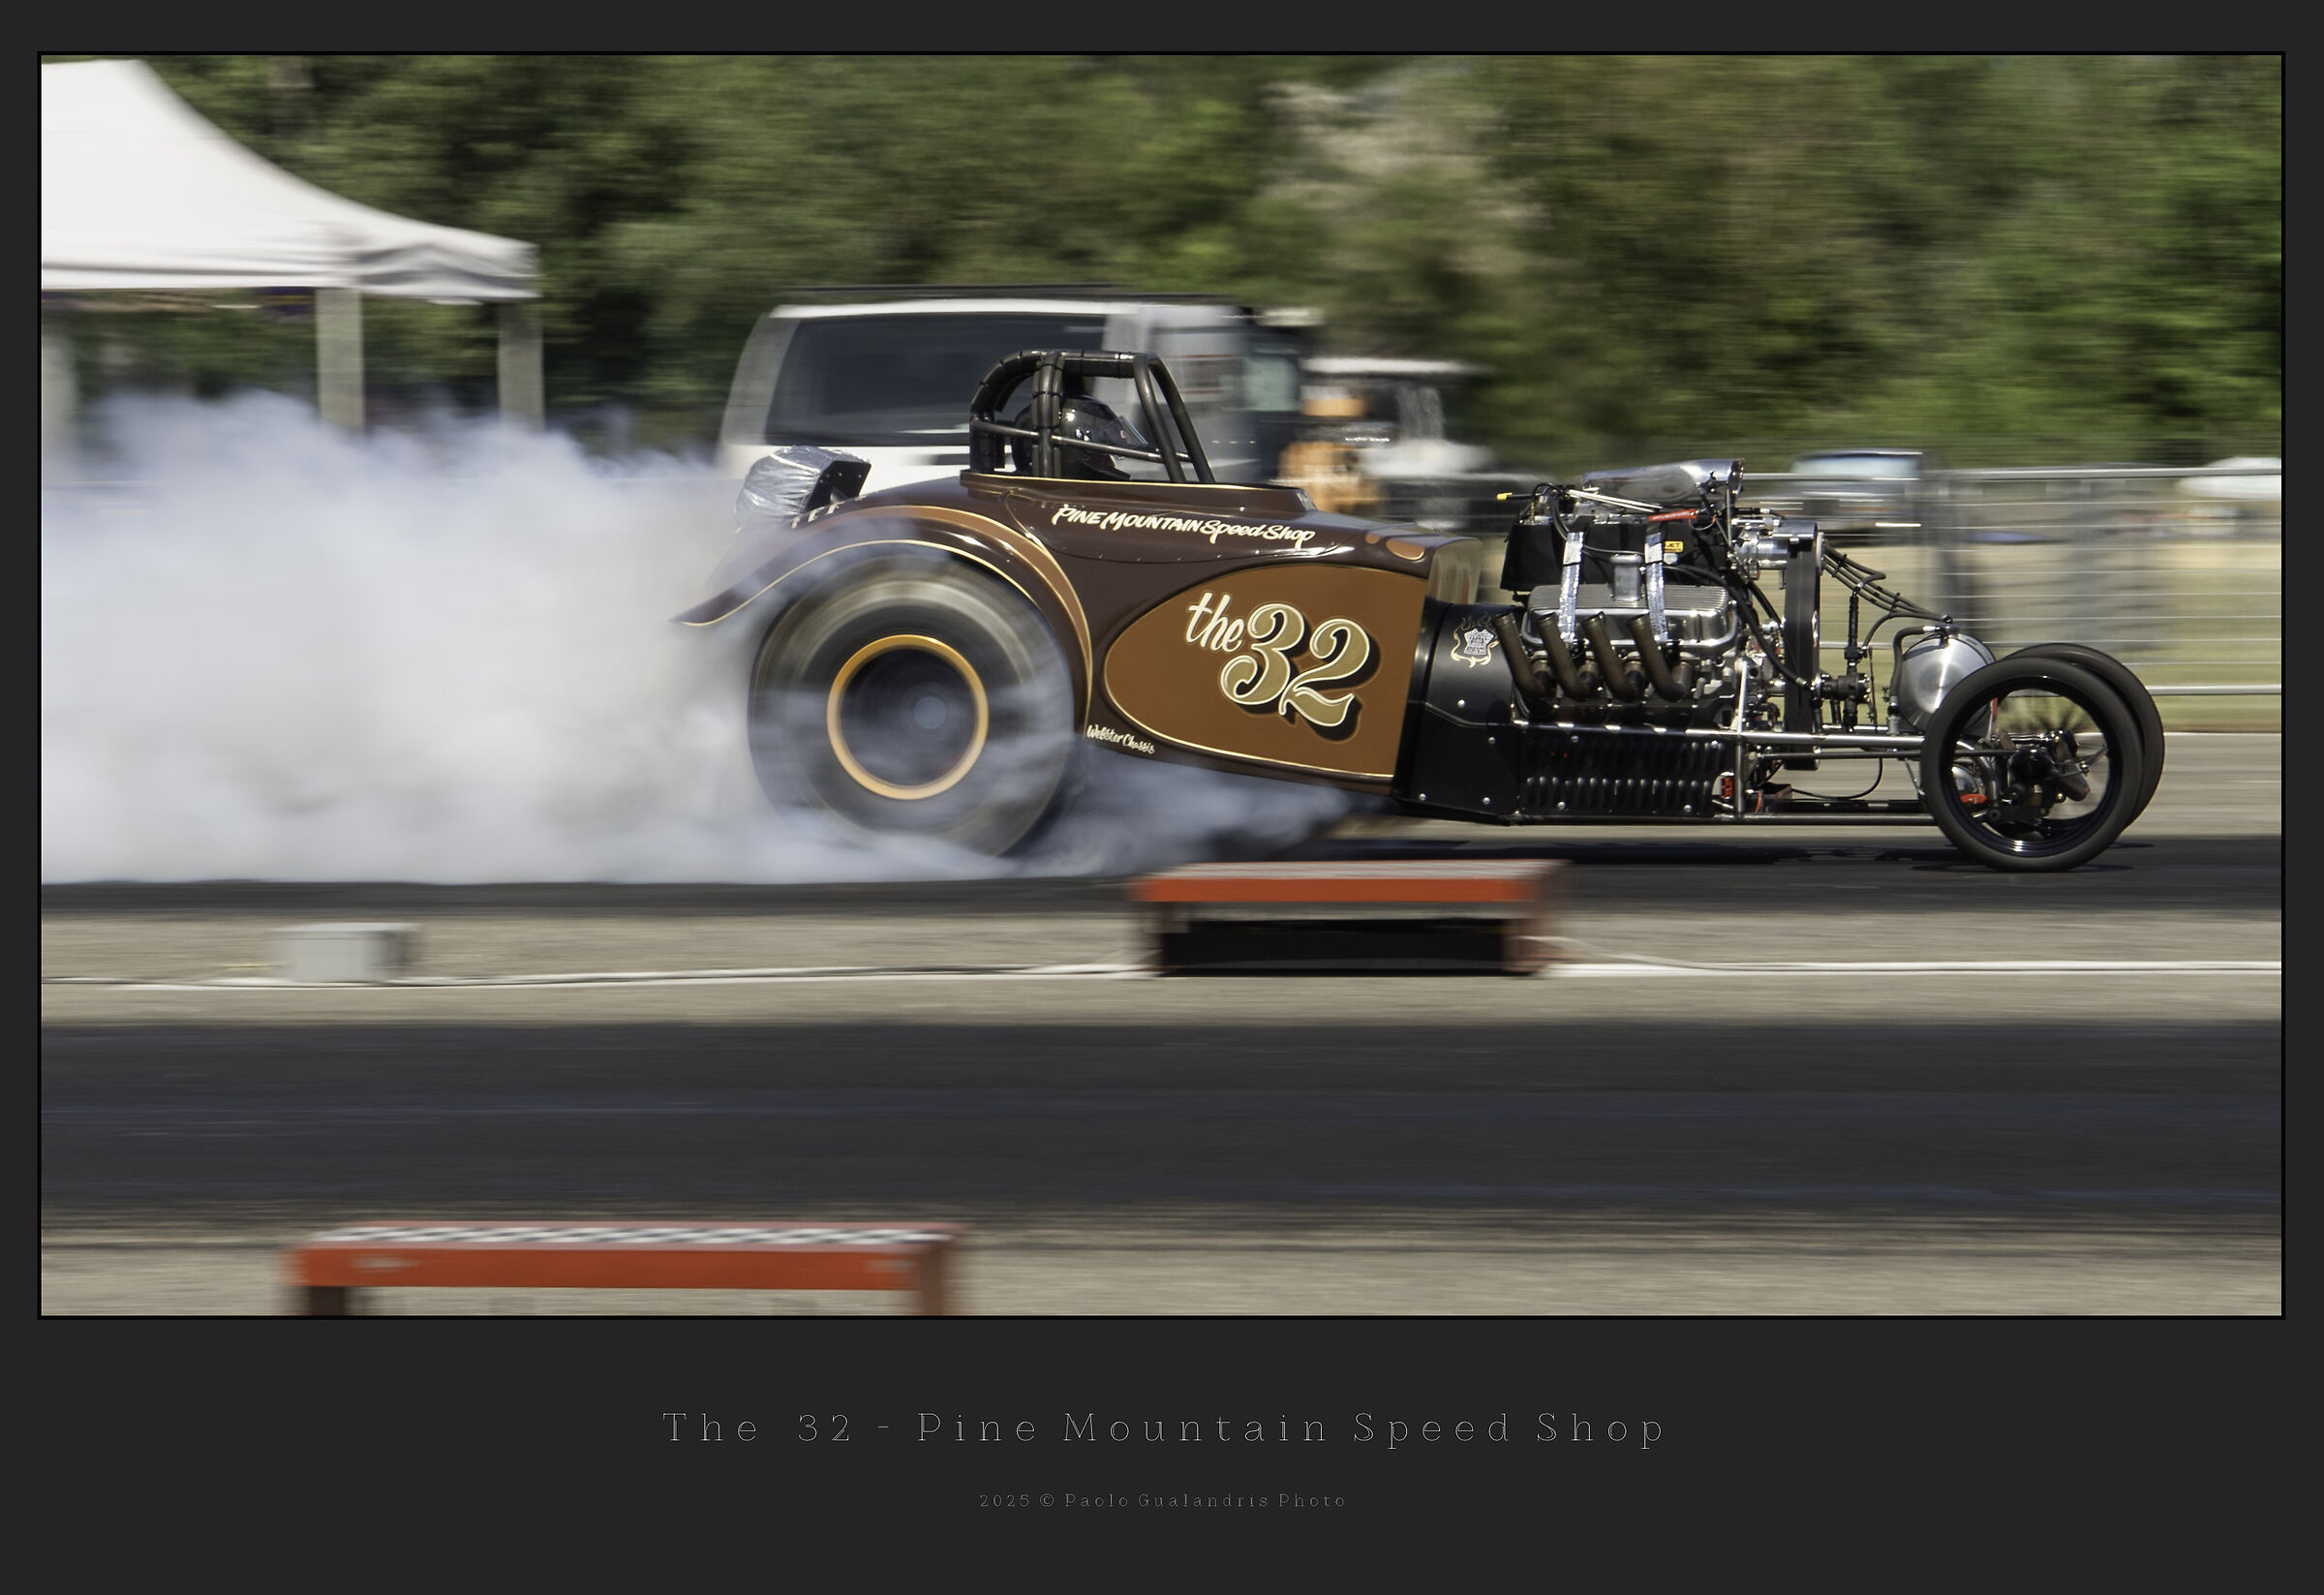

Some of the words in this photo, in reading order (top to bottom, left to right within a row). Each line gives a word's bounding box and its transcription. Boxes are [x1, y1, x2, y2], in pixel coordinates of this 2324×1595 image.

[1052, 506, 1108, 526] PINE
[1099, 511, 1203, 533] MOUNTAIN
[1200, 519, 1267, 544] Speed
[1263, 524, 1316, 549] Shop
[1186, 592, 1245, 653] the
[1220, 602, 1370, 727] 32
[1122, 733, 1155, 754] Chassis
